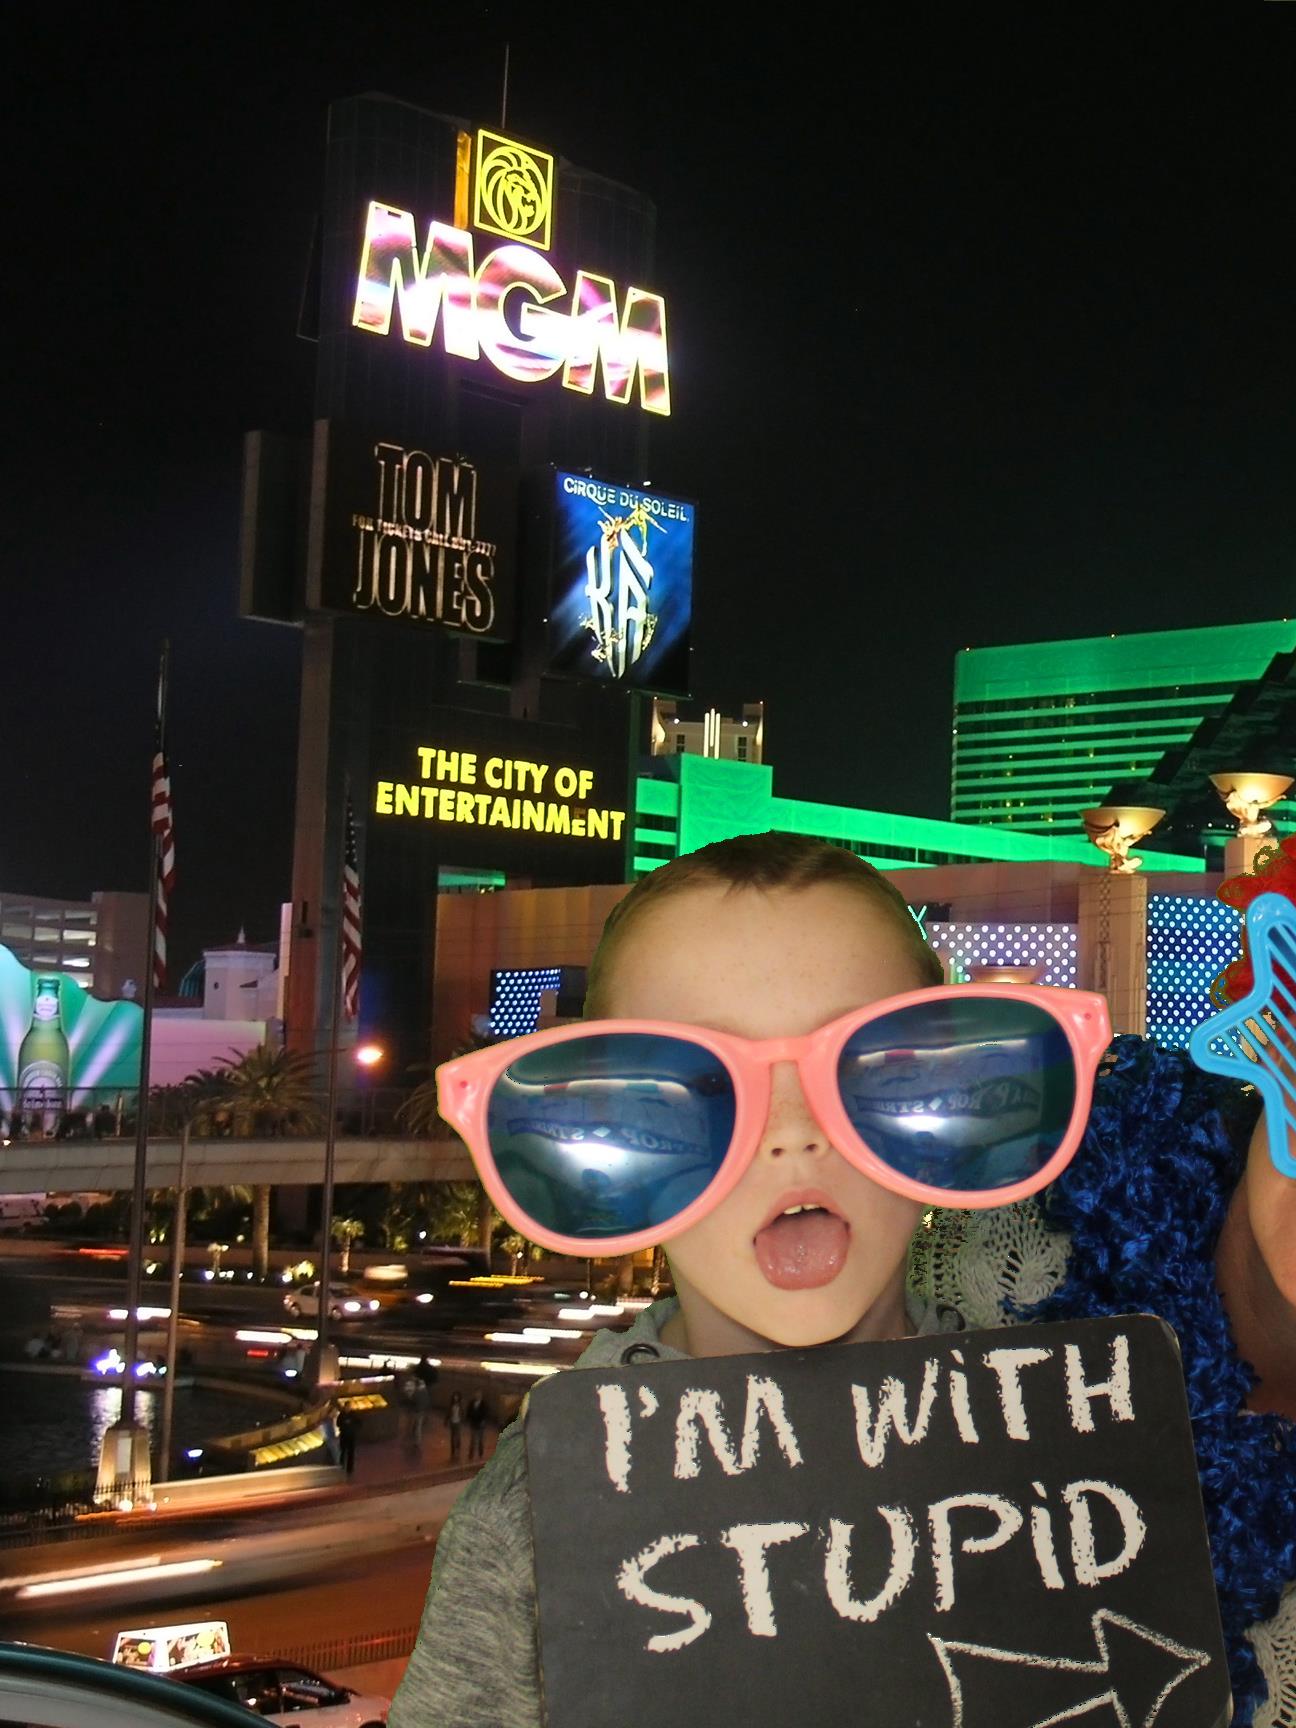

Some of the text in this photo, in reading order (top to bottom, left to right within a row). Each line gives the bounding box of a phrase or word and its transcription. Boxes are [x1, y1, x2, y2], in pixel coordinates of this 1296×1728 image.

[353, 200, 671, 416] MGM
[374, 442, 477, 540] TOM
[641, 498, 687, 521] SOLEIL
[353, 530, 495, 632] JONES
[376, 781, 626, 840] ENTERTAINMENT
[417, 746, 593, 800] THE CITY OF
[596, 1374, 804, 1493] I'M
